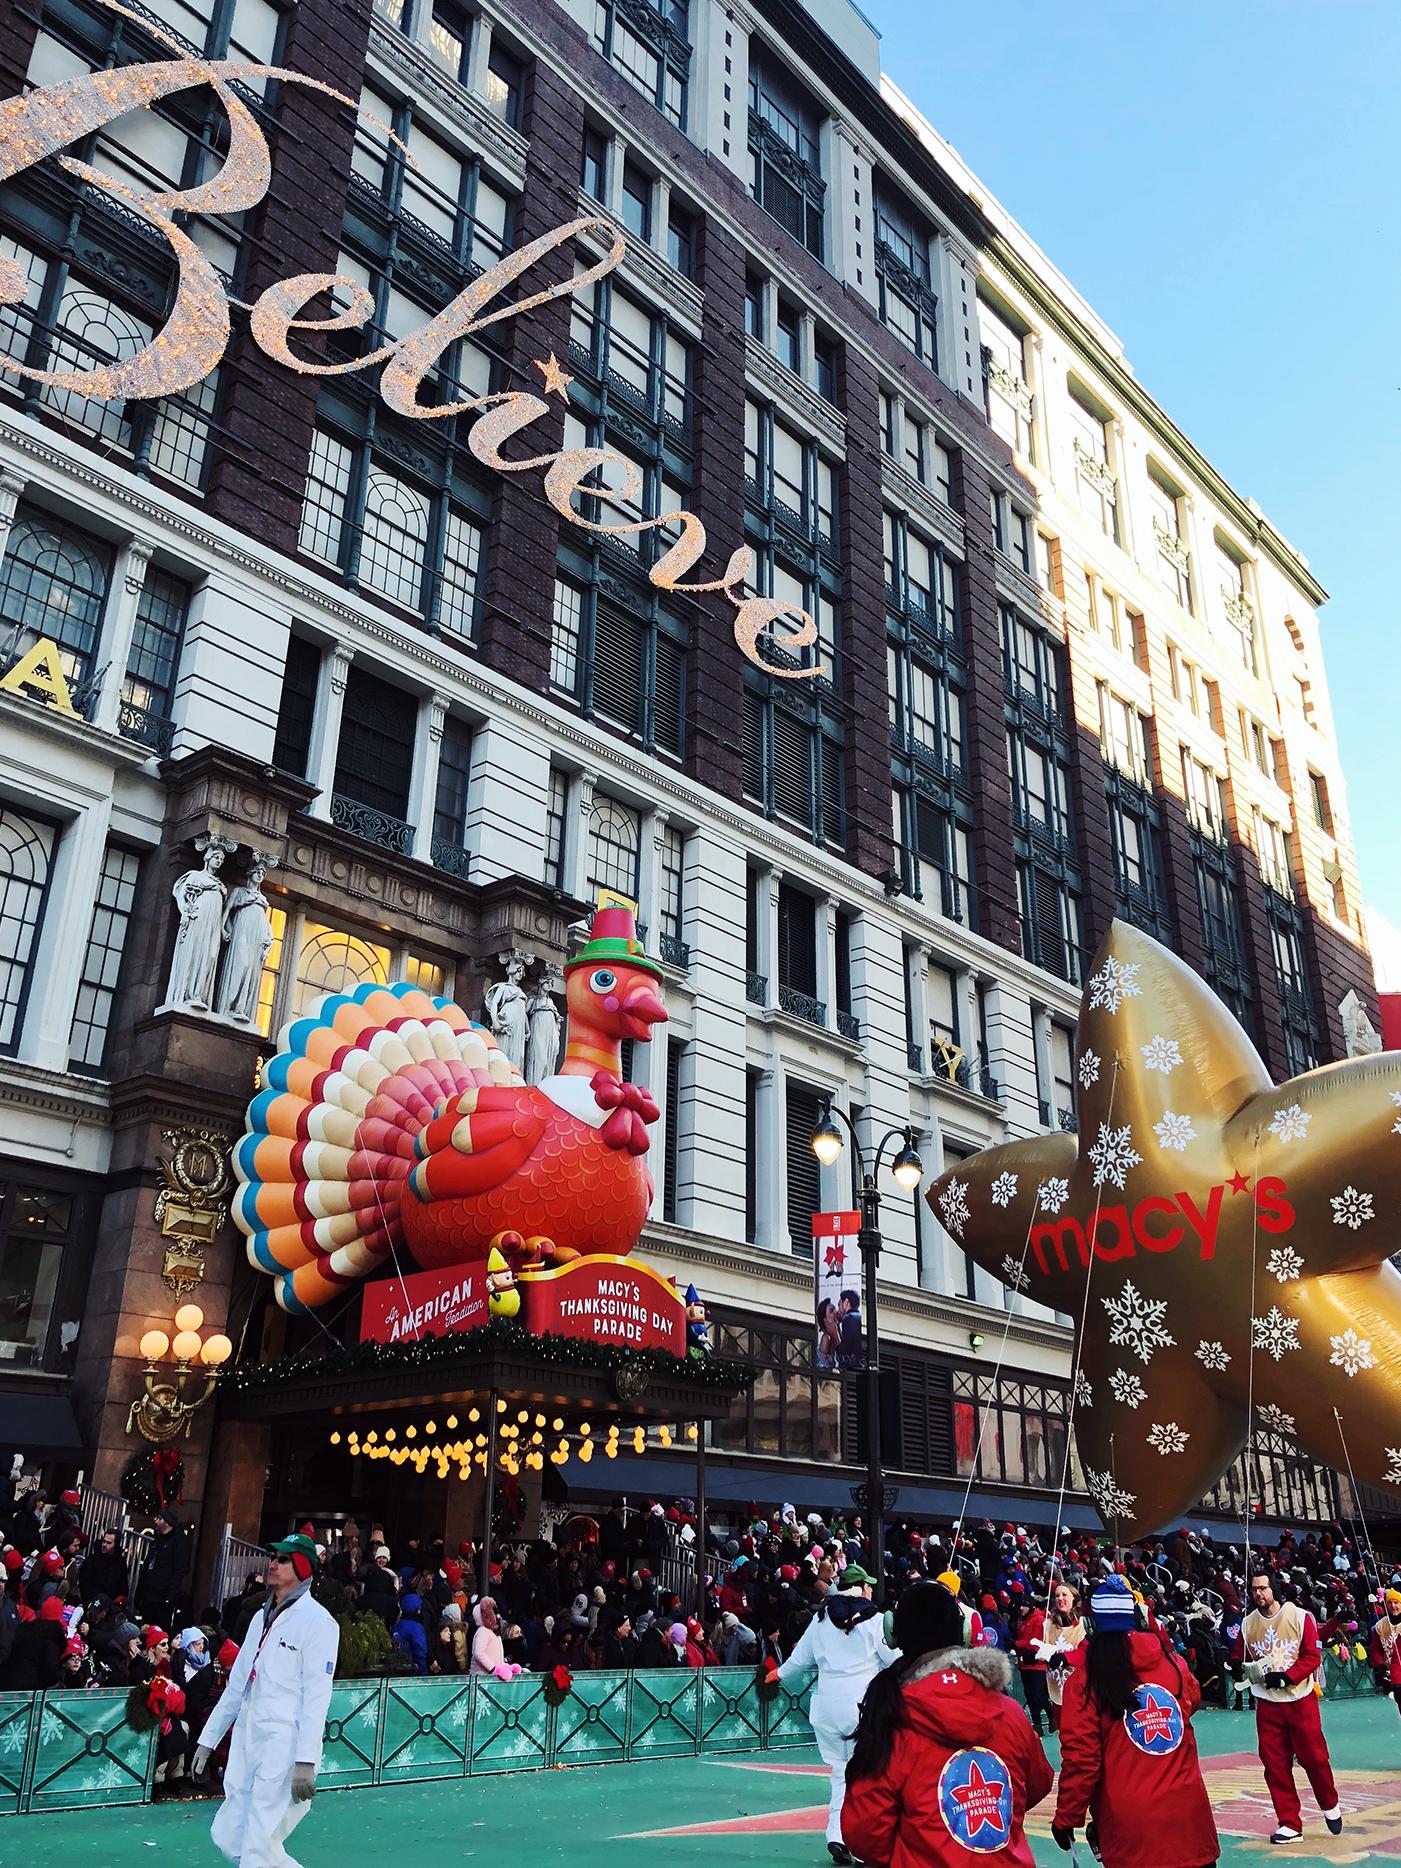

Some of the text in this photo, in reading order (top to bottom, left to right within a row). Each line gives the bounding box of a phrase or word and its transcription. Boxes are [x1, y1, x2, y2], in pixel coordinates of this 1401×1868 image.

[0, 0, 828, 678] Believe
[598, 1279, 640, 1302] MACY'S
[385, 1306, 400, 1324] An
[390, 1277, 472, 1343] AMERICAN
[445, 1299, 484, 1328] Tradition
[560, 1298, 673, 1335] THANKSGIVING DAY
[594, 1318, 642, 1342] PARADE
[967, 1786, 991, 1799] MACY'S
[952, 1797, 997, 1815] THANKSGIVING
[969, 1805, 998, 1817] PARADE
